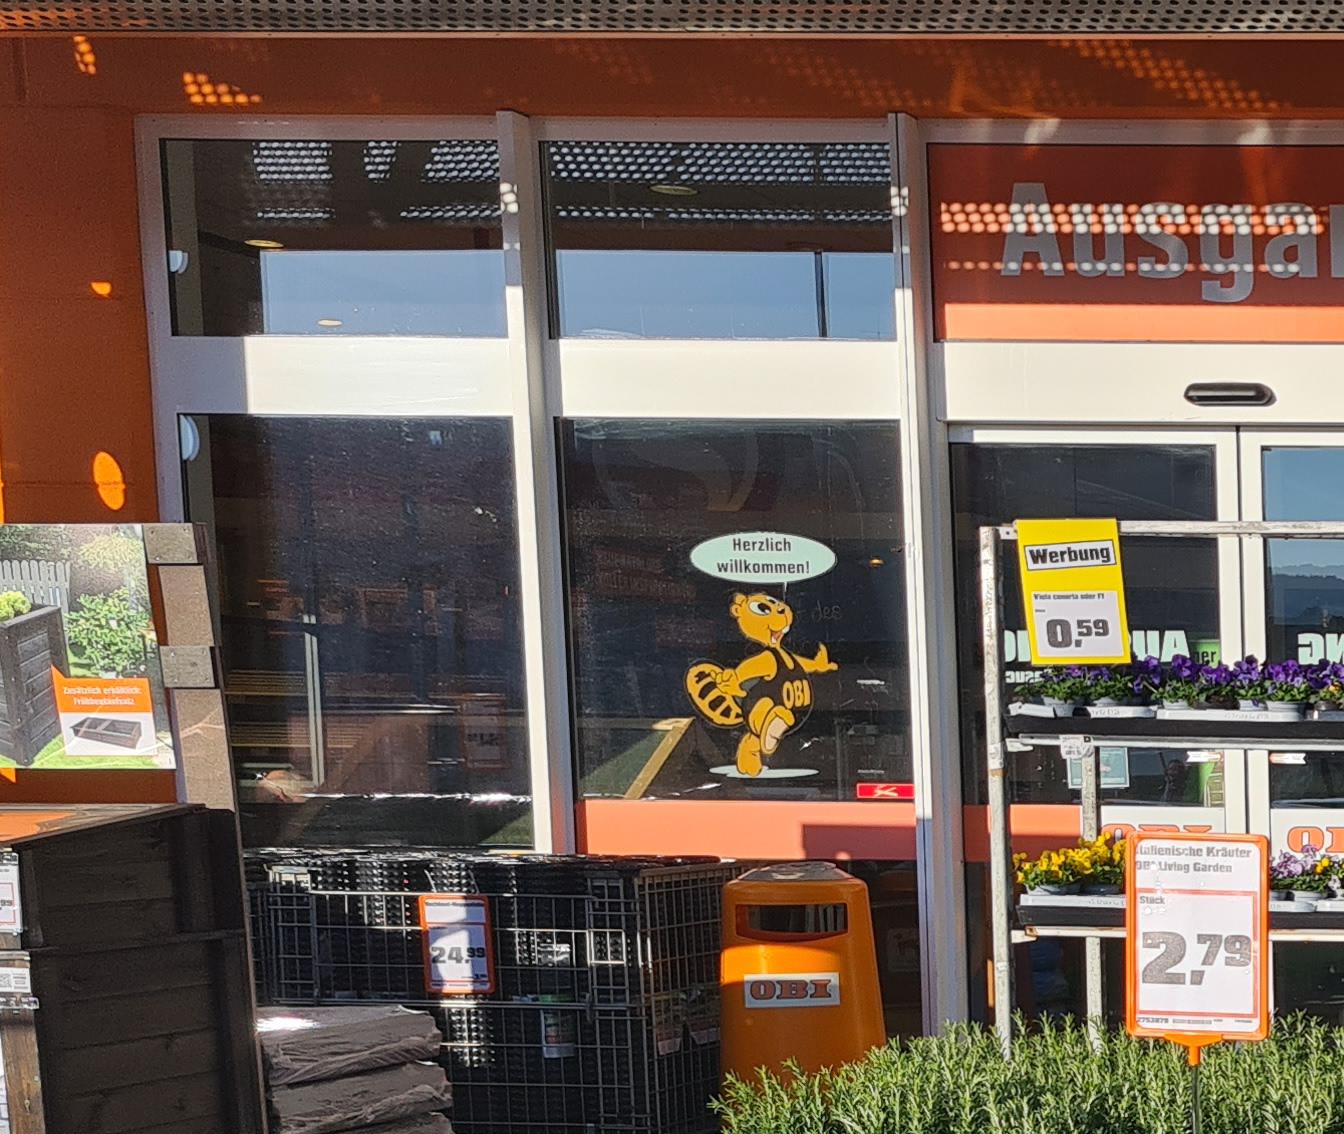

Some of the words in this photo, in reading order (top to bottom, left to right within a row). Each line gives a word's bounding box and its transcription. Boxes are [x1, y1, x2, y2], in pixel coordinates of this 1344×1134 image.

[733, 538, 792, 551] Herzlich
[1029, 547, 1112, 564] Werbung
[717, 559, 810, 574] willkommen!
[1046, 619, 1110, 649] 0,59
[782, 679, 811, 710] OBI
[1207, 845, 1253, 858] Kräuter
[1159, 861, 1190, 873] Living
[1193, 862, 1232, 873] Garden
[1139, 895, 1165, 905] Stück
[1142, 931, 1252, 985] 2,79
[750, 979, 831, 1001] OBI
